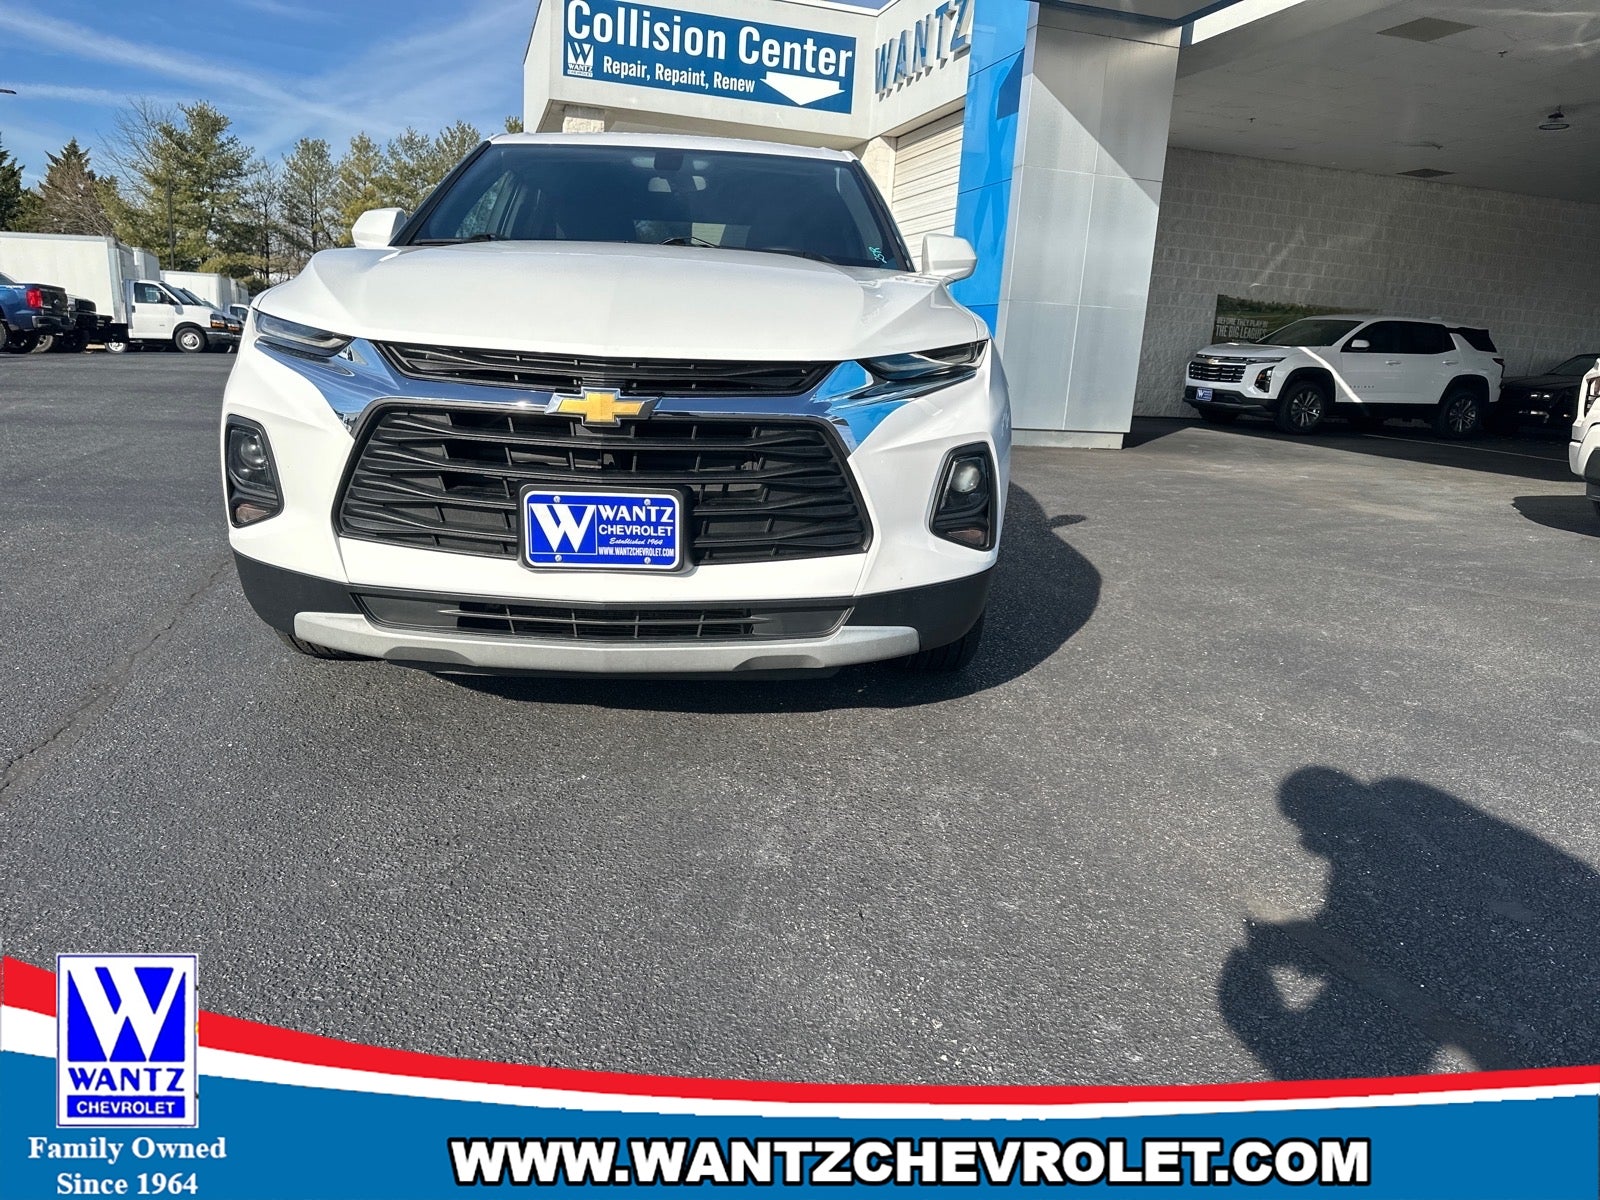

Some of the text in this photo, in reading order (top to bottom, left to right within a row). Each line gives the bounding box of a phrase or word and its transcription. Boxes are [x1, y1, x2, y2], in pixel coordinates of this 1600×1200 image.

[567, 0, 853, 77] Collision Center
[875, 0, 970, 95] WANTZ
[568, 63, 593, 73] WANTZ
[603, 55, 756, 93] Repair, Repaint, Renew
[1216, 324, 1229, 337] THE
[1228, 325, 1240, 338] BIG
[597, 504, 674, 523] WANTZ
[530, 503, 597, 553] W
[598, 523, 674, 537] CHEVROLET
[609, 537, 645, 545] Established
[598, 546, 675, 557] WWW.WANTZCHEVROLET.COM
